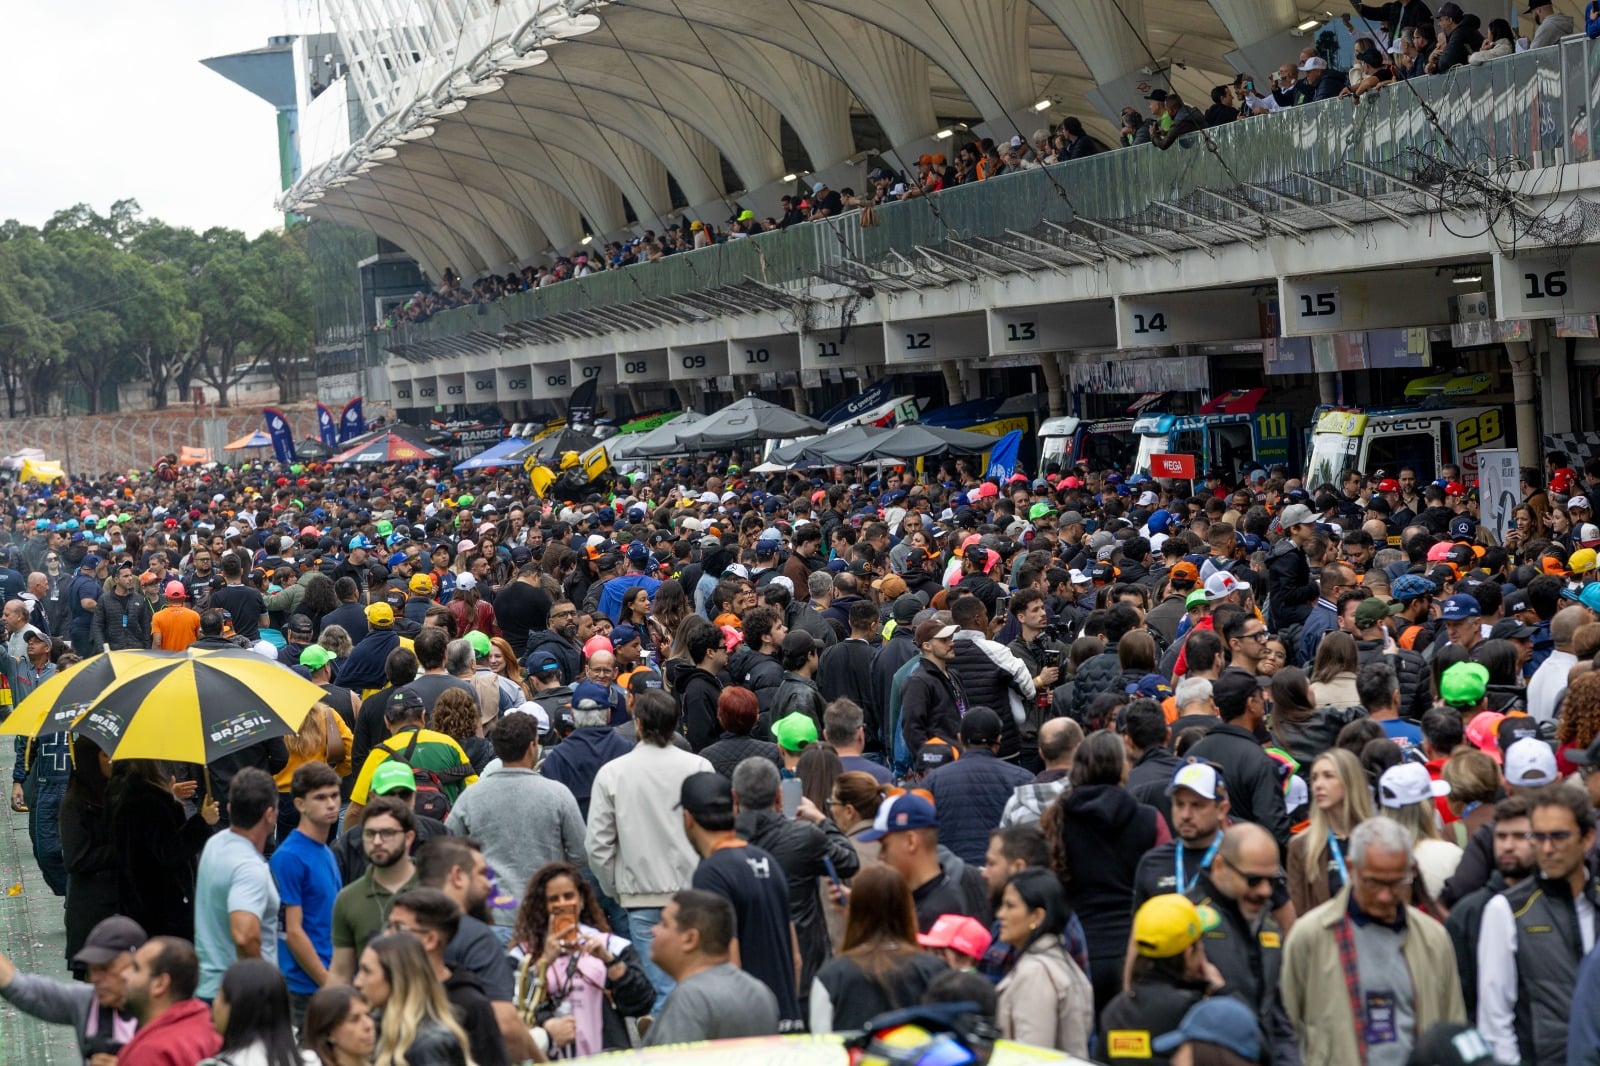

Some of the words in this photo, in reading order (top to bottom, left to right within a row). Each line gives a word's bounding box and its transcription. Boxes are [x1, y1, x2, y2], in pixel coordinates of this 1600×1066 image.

[1525, 270, 1568, 299] 16
[1300, 293, 1336, 317] 15
[1133, 313, 1168, 334] 14
[1007, 322, 1036, 342] 13
[906, 332, 931, 349] 12
[746, 349, 770, 363] 10
[818, 342, 840, 357] 11
[625, 361, 647, 374] 08
[682, 355, 706, 369] 09
[583, 366, 601, 378] 07
[475, 380, 493, 391] 04
[509, 379, 527, 390] 05
[547, 375, 567, 386] 06
[398, 390, 411, 399] 01
[420, 388, 435, 398] 02
[447, 385, 463, 395] 03
[1257, 413, 1287, 438] 111
[1372, 417, 1443, 433] IVECO
[1457, 409, 1501, 451] 28
[1163, 459, 1183, 471] WEGA
[55, 708, 89, 721] BRA
[89, 713, 119, 737] BRASIL
[211, 716, 272, 742] BRASIL
